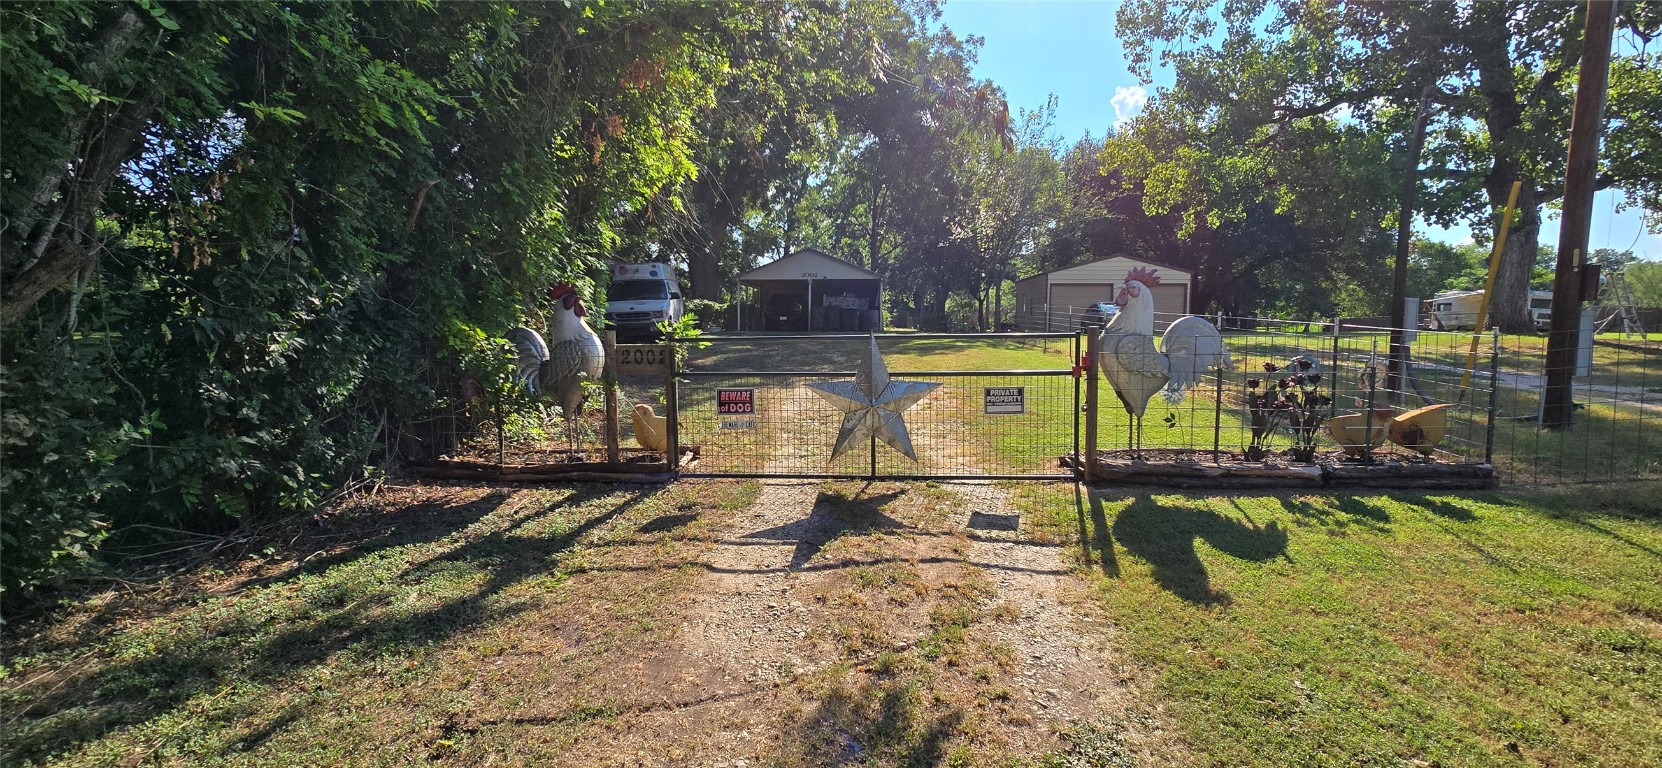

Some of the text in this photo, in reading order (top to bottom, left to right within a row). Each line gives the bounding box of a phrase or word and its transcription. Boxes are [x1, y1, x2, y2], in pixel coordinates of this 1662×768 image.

[720, 391, 751, 401] BEWARE
[720, 403, 752, 412] of DOG
